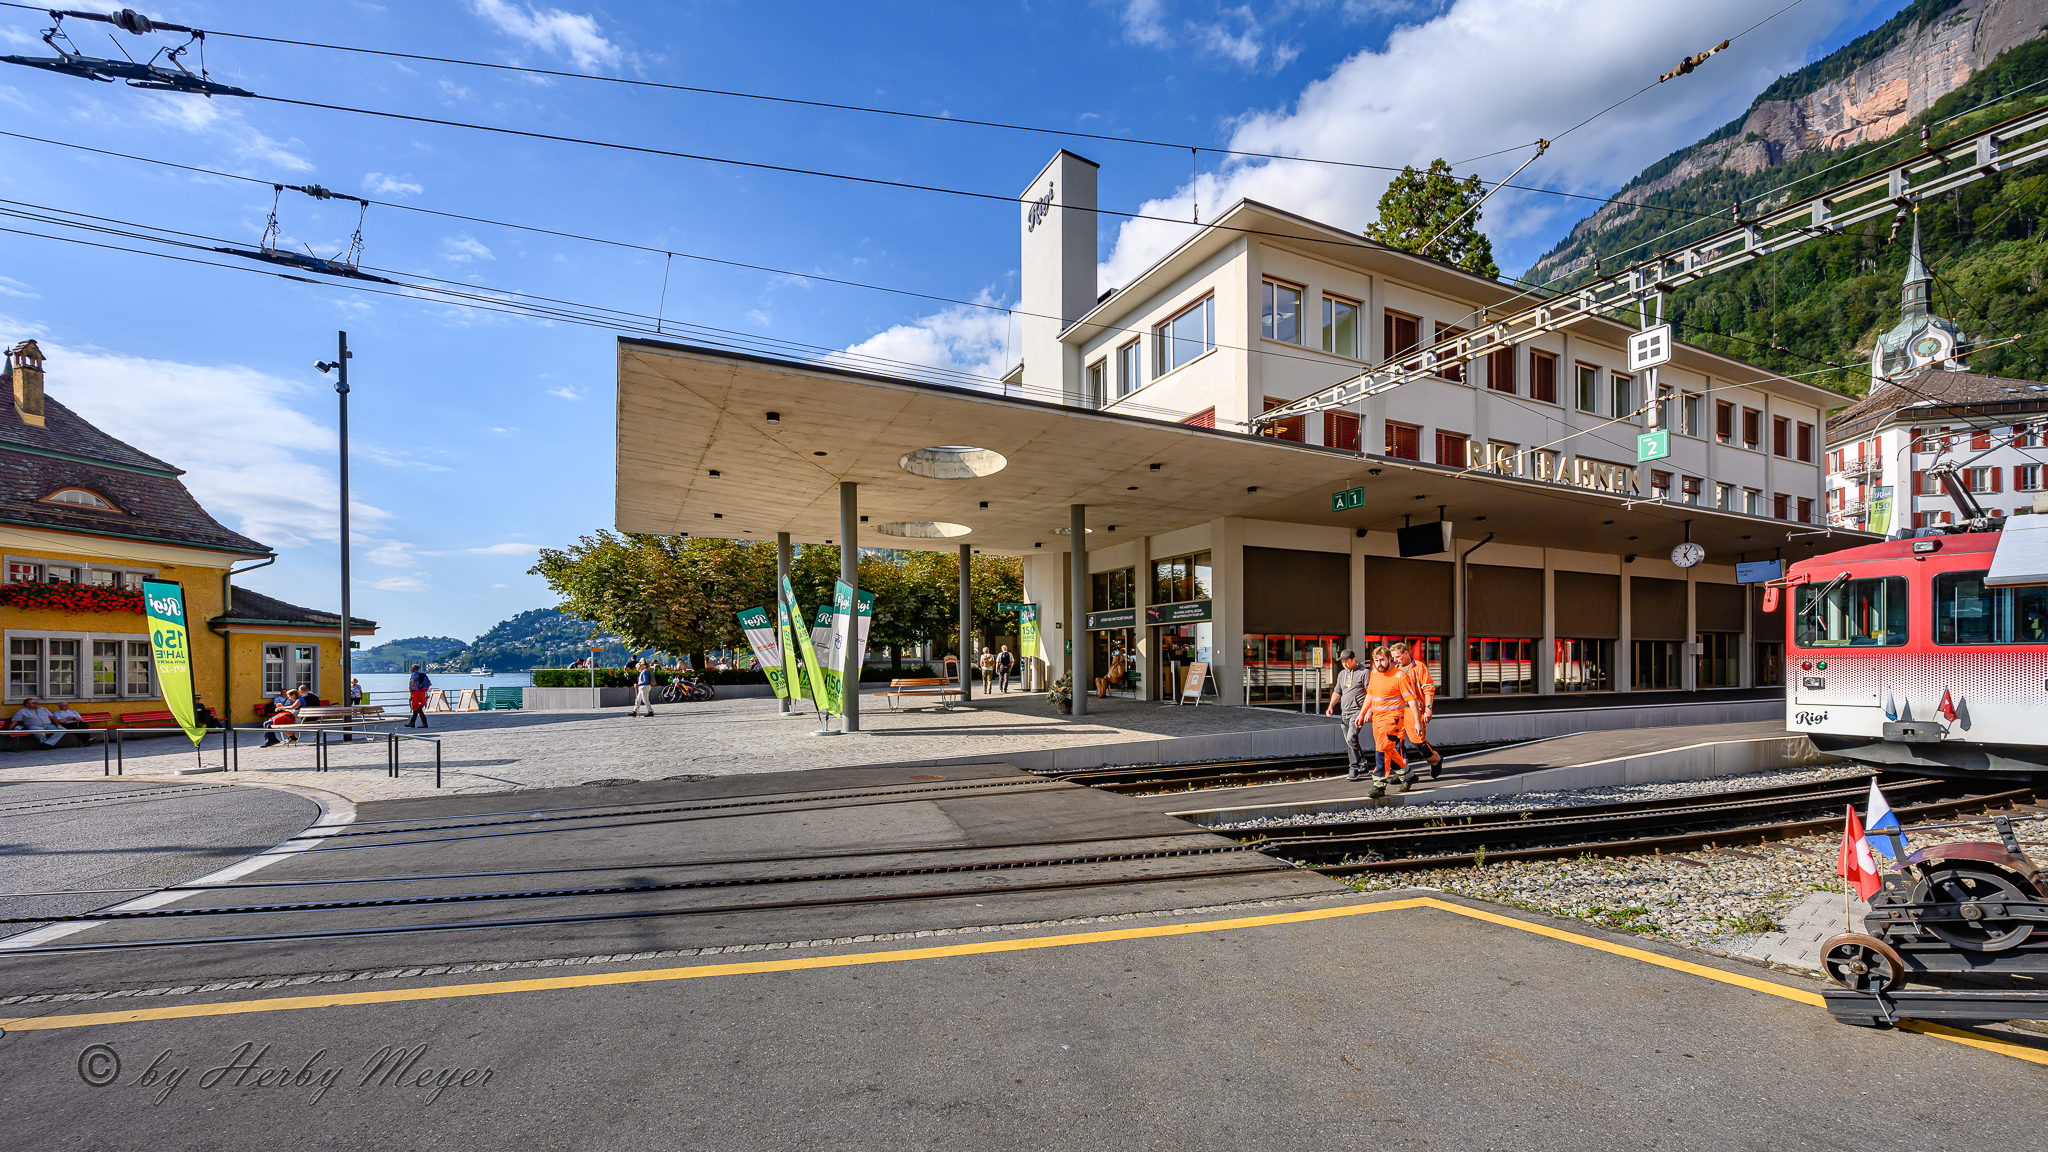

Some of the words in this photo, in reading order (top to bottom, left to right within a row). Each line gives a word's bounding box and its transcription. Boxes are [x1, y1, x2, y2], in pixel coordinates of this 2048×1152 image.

[1028, 181, 1054, 232] Rigi
[1647, 441, 1658, 456] 2
[1466, 439, 1526, 476] RIGI
[1540, 453, 1641, 494] BAHNEN
[1336, 498, 1344, 509] A
[1352, 494, 1357, 505] 1
[1874, 490, 1891, 499] Rigi
[1875, 501, 1891, 509] 150
[835, 592, 850, 610] Rigi
[858, 600, 870, 612] igi
[818, 612, 832, 625] Ri
[1022, 626, 1034, 635] 150
[827, 673, 841, 694] 150
[1795, 710, 1829, 726] Rigi
